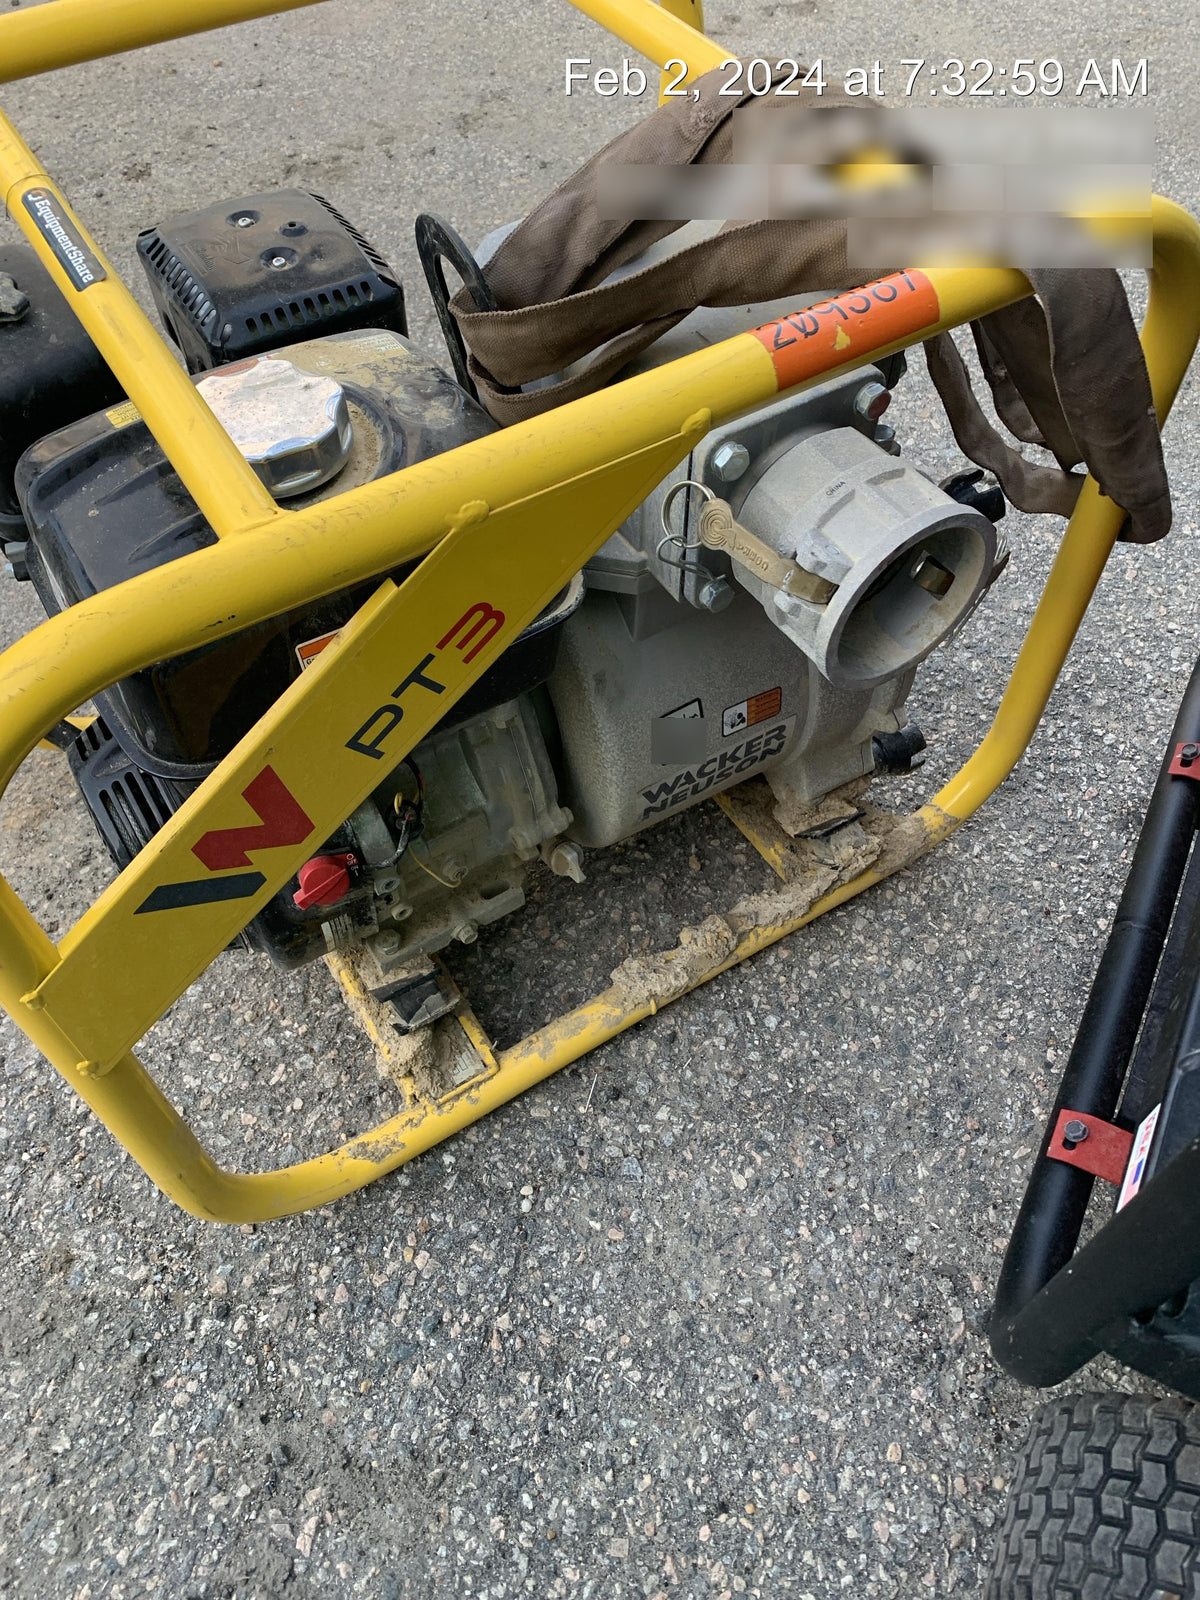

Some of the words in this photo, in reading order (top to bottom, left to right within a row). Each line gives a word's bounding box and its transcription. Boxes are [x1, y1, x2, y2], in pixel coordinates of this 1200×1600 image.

[34, 199, 95, 283] EquipmentShare
[825, 481, 846, 496] CHINA
[344, 602, 506, 760] PT3
[639, 740, 786, 821] NEUSON
[642, 724, 787, 804] WACKER
